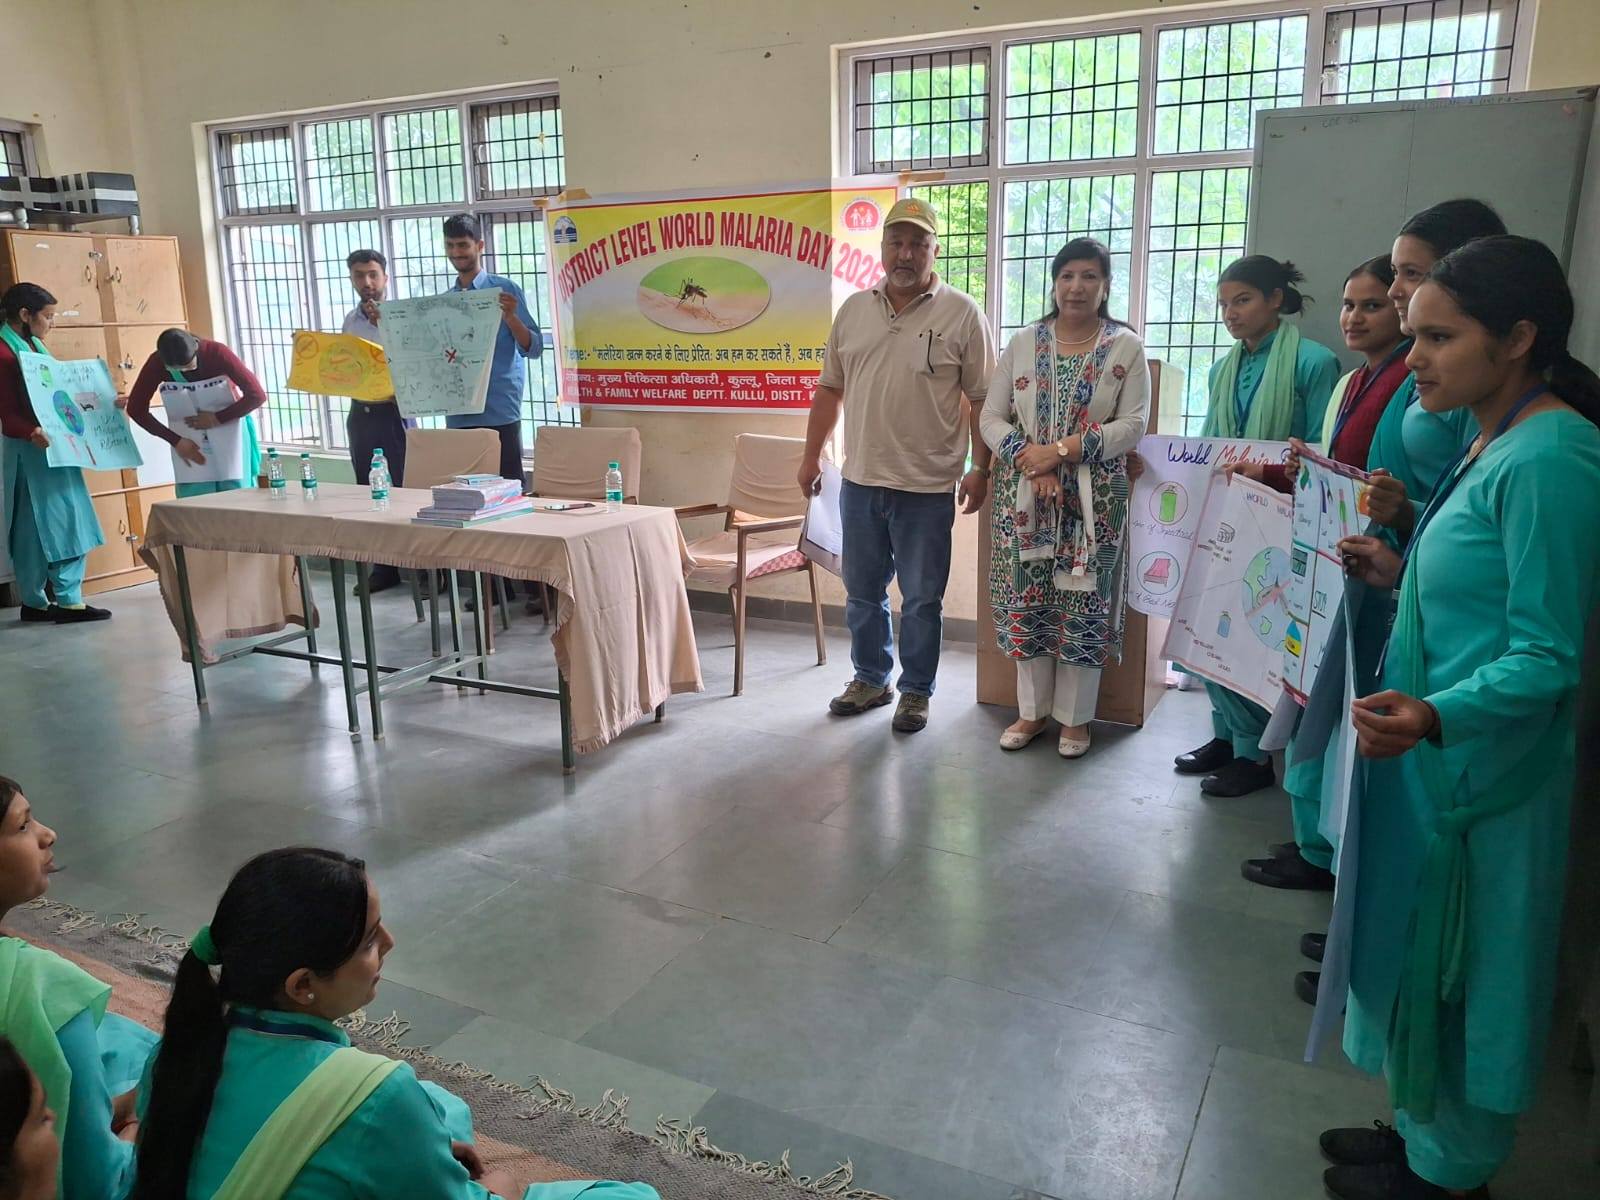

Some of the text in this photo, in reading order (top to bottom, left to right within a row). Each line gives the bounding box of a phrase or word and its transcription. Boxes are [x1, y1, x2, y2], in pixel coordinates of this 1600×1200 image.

[557, 238, 610, 302] DISTRICT
[610, 220, 657, 266] LEVEL
[658, 211, 715, 251] WORLD
[720, 211, 795, 258] MALARIA
[796, 226, 835, 271] DAY
[645, 343, 662, 361] करने
[664, 343, 672, 361] के
[674, 344, 690, 362] लिए
[715, 347, 729, 361] अब
[731, 347, 743, 364] हम
[745, 347, 759, 361] कर
[761, 343, 782, 361] सकते
[798, 347, 813, 361] अब
[597, 373, 622, 387] मुख्य
[624, 371, 668, 385] चिकित्सा
[671, 371, 724, 386] अधिकारी,
[727, 374, 762, 389] कुल्लू,
[765, 372, 796, 386] जिला
[595, 387, 603, 398] &
[604, 387, 640, 399] FAMILY
[641, 388, 688, 400] WELFARE
[692, 388, 728, 401] DEPTT.
[730, 389, 768, 402] KULLU,
[771, 389, 806, 402] DISTT.
[1167, 441, 1213, 466] World
